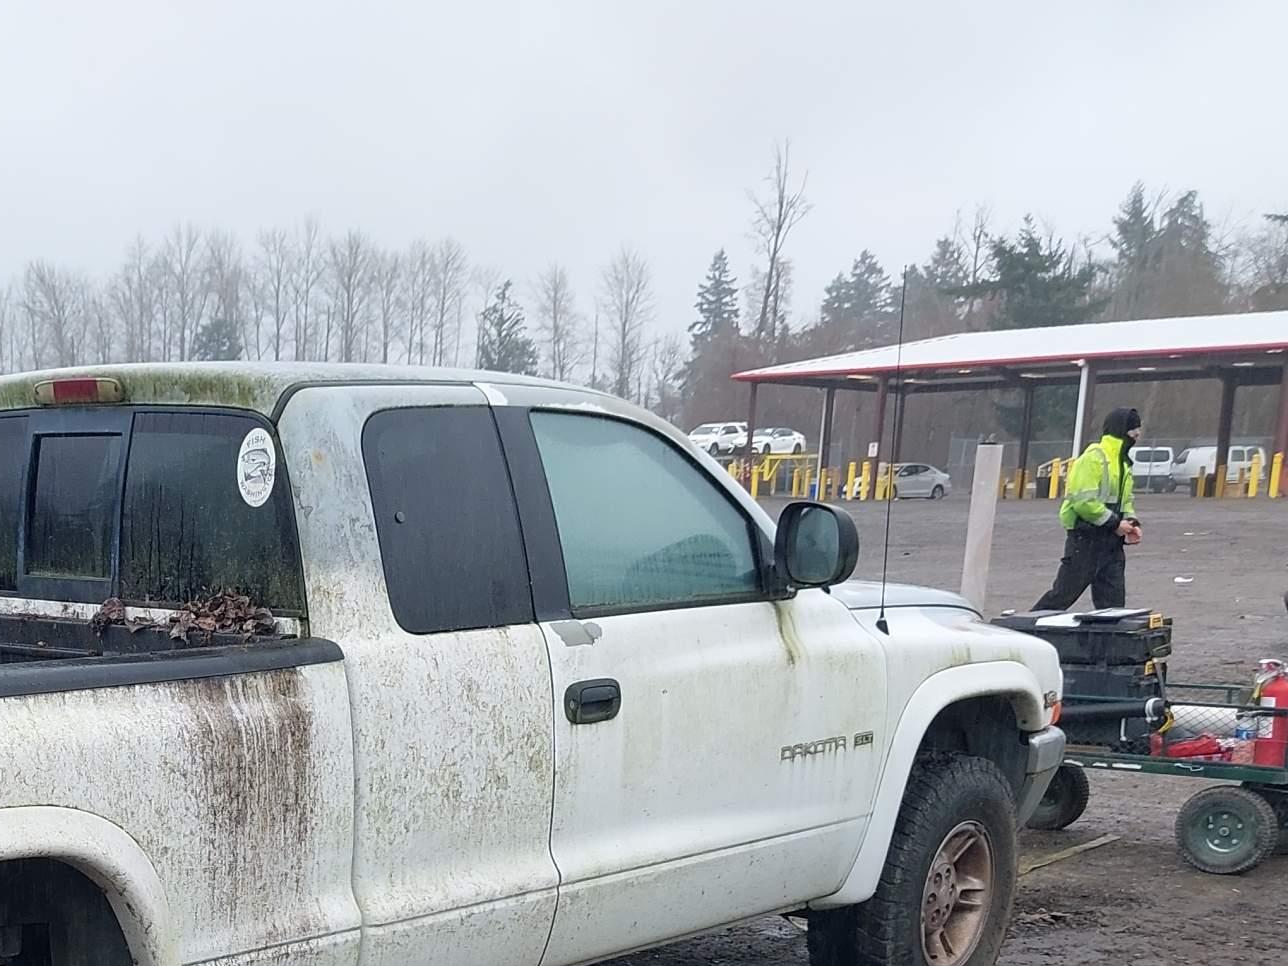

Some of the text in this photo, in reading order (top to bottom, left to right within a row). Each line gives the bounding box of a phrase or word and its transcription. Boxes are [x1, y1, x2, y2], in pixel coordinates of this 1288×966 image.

[246, 435, 266, 448] FISH
[780, 732, 873, 761] DAKOTA SLT
